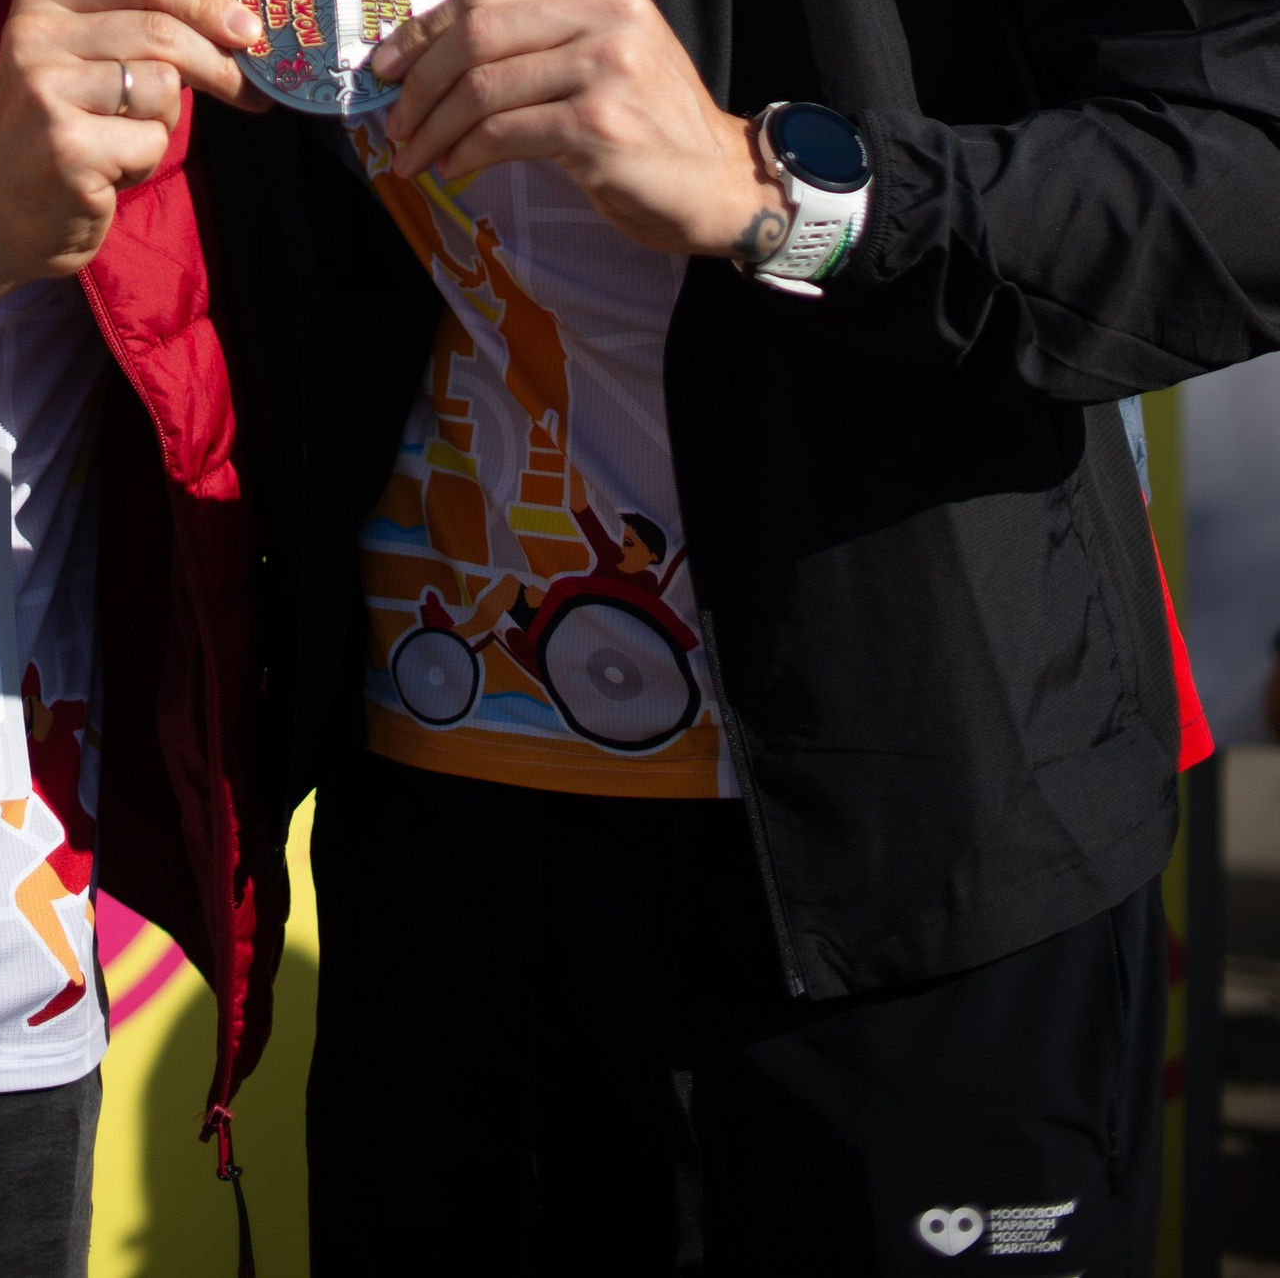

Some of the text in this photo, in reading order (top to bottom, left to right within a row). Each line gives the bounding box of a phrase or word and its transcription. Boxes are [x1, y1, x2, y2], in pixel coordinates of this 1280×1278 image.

[991, 1218, 1056, 1231] МАРАФОН
[991, 1230, 1049, 1243] MOSCOW
[992, 1240, 1061, 1255] MARATHON
